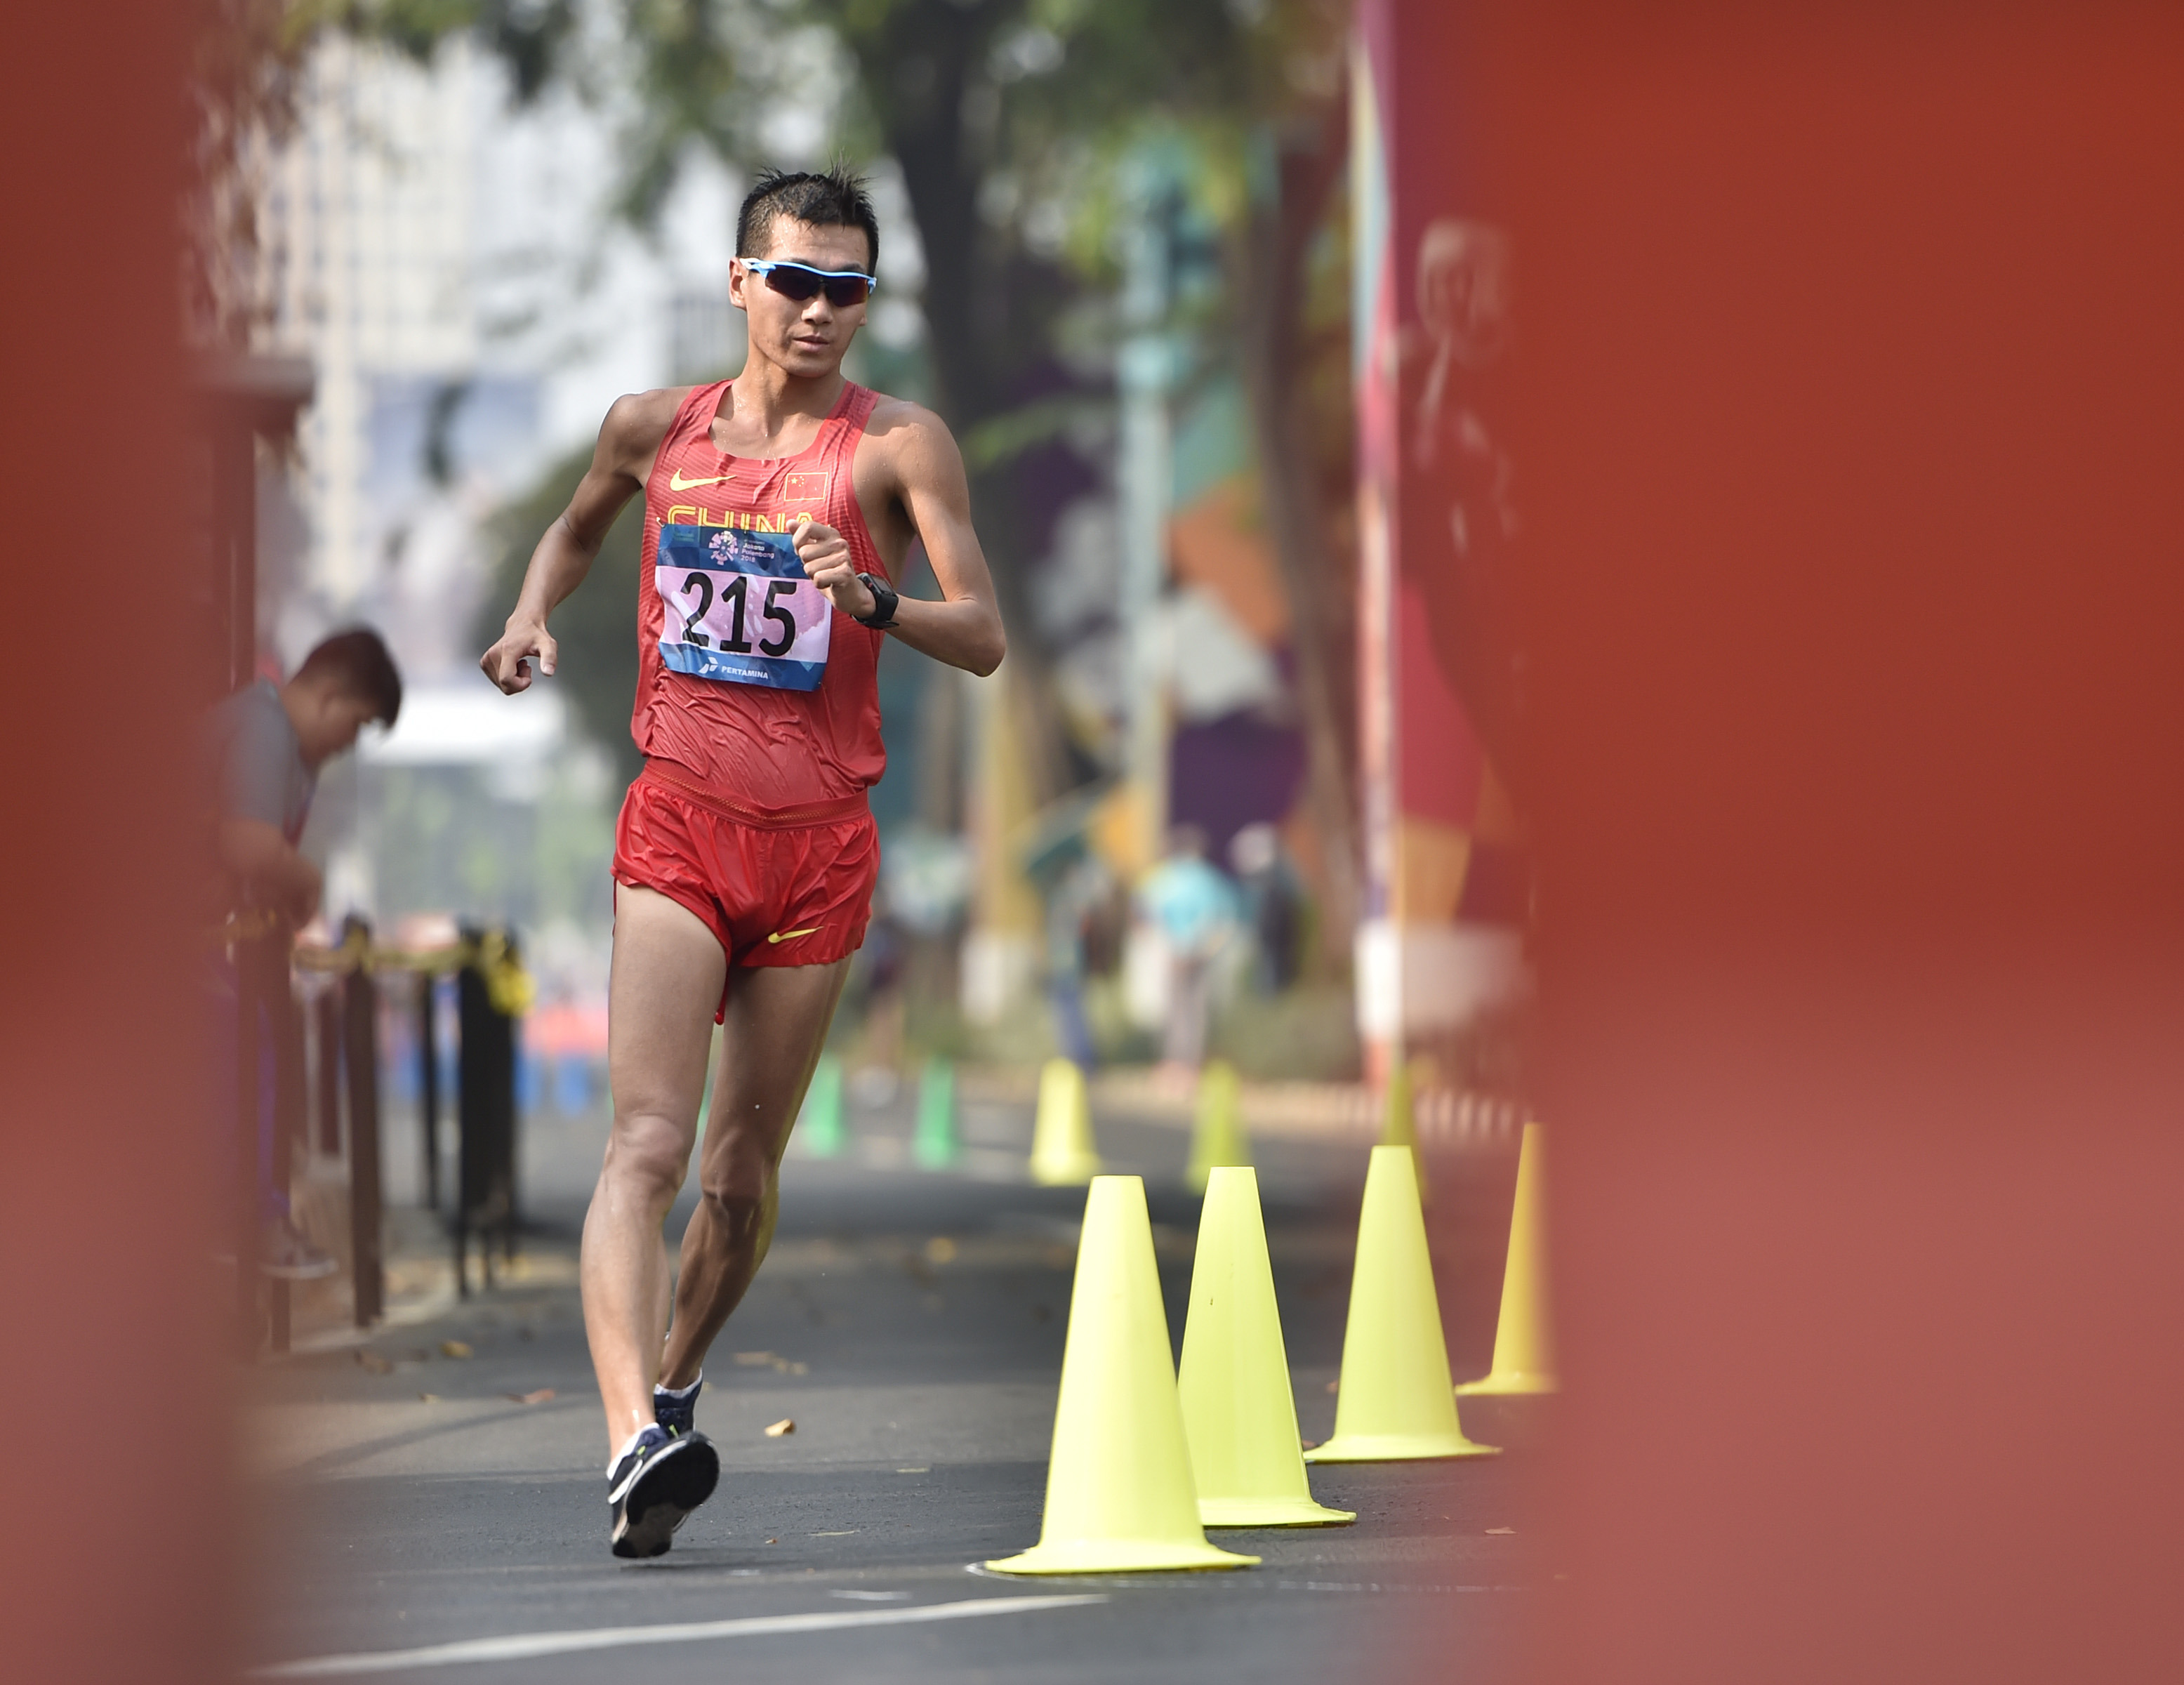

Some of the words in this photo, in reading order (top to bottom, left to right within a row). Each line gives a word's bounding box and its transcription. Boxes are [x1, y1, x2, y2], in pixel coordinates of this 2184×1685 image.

[668, 505, 814, 534] CHIN
[741, 548, 775, 559] Palembang
[680, 571, 798, 657] 215
[721, 666, 769, 679] PERTAMINA
